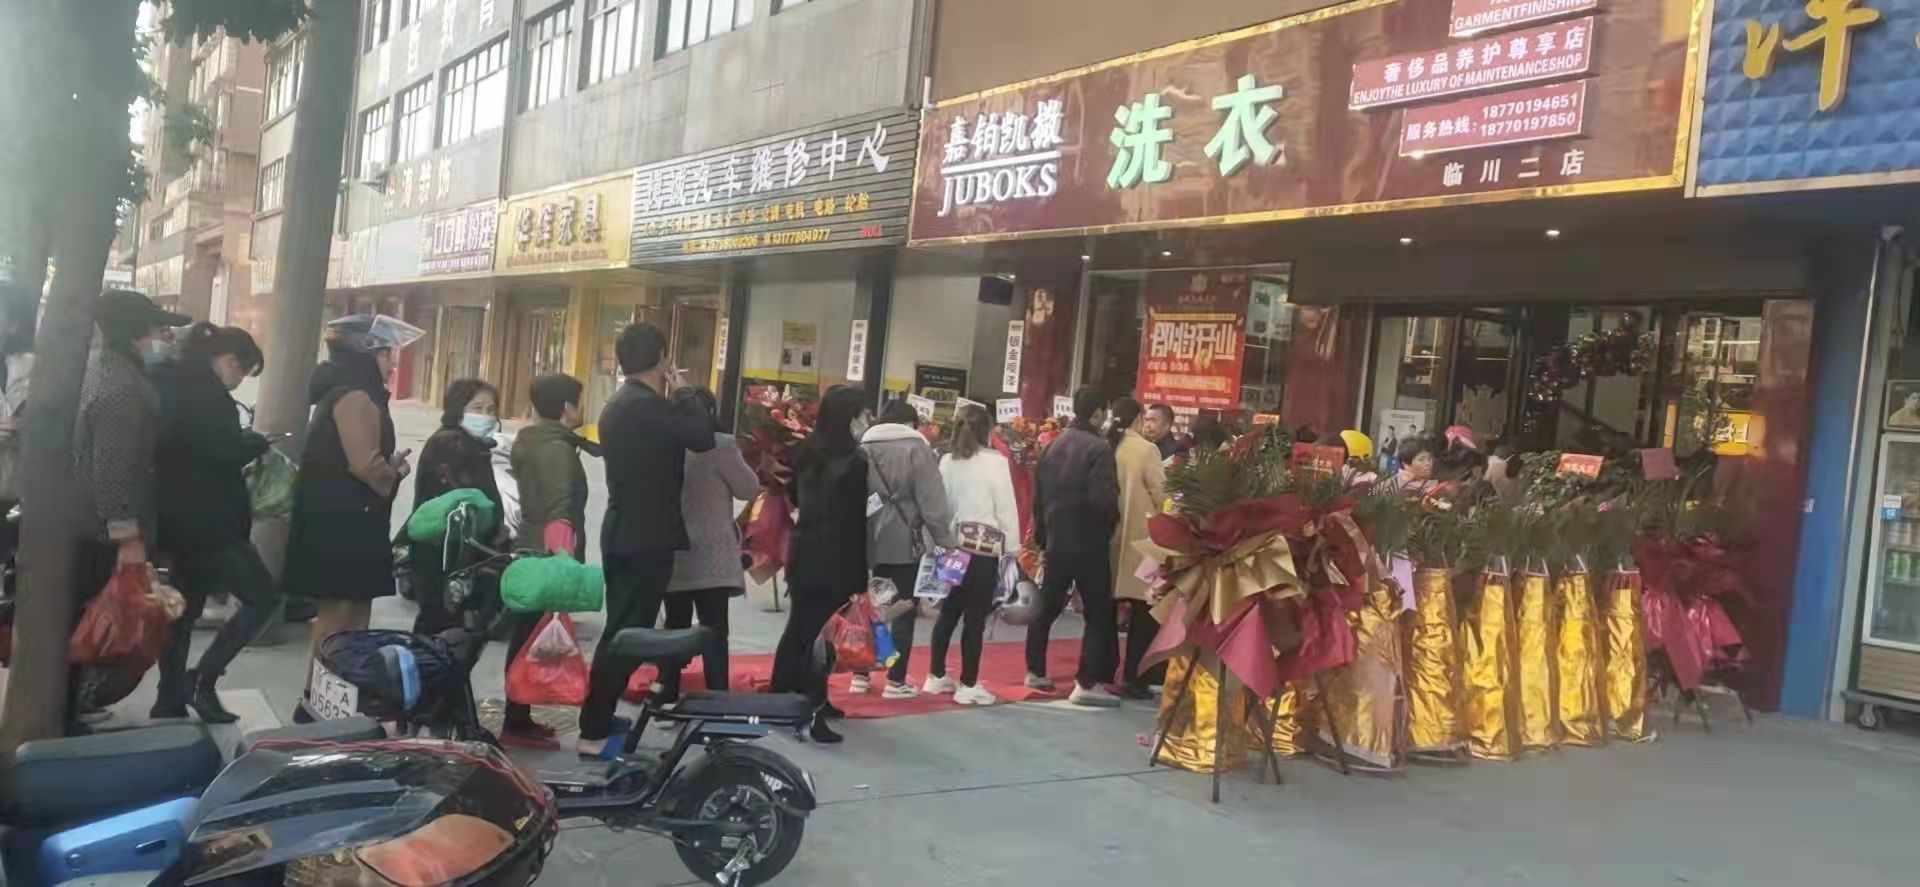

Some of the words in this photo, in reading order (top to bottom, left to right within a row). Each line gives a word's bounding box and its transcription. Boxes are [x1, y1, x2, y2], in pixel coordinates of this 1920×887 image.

[1454, 0, 1592, 30] GARMENTFINISH
[1384, 26, 1587, 83] 奢侈品养护尊享店
[1406, 73, 1447, 96] LUXURY
[1450, 69, 1464, 89] OF
[1465, 52, 1583, 85] MAINTENANCESHOP
[1480, 112, 1577, 137] 18770197850
[1482, 93, 1578, 119] 18770194651
[1106, 74, 1283, 190] 洗衣
[1442, 148, 1585, 187] 临川二店
[937, 163, 1058, 217] JUBOKS
